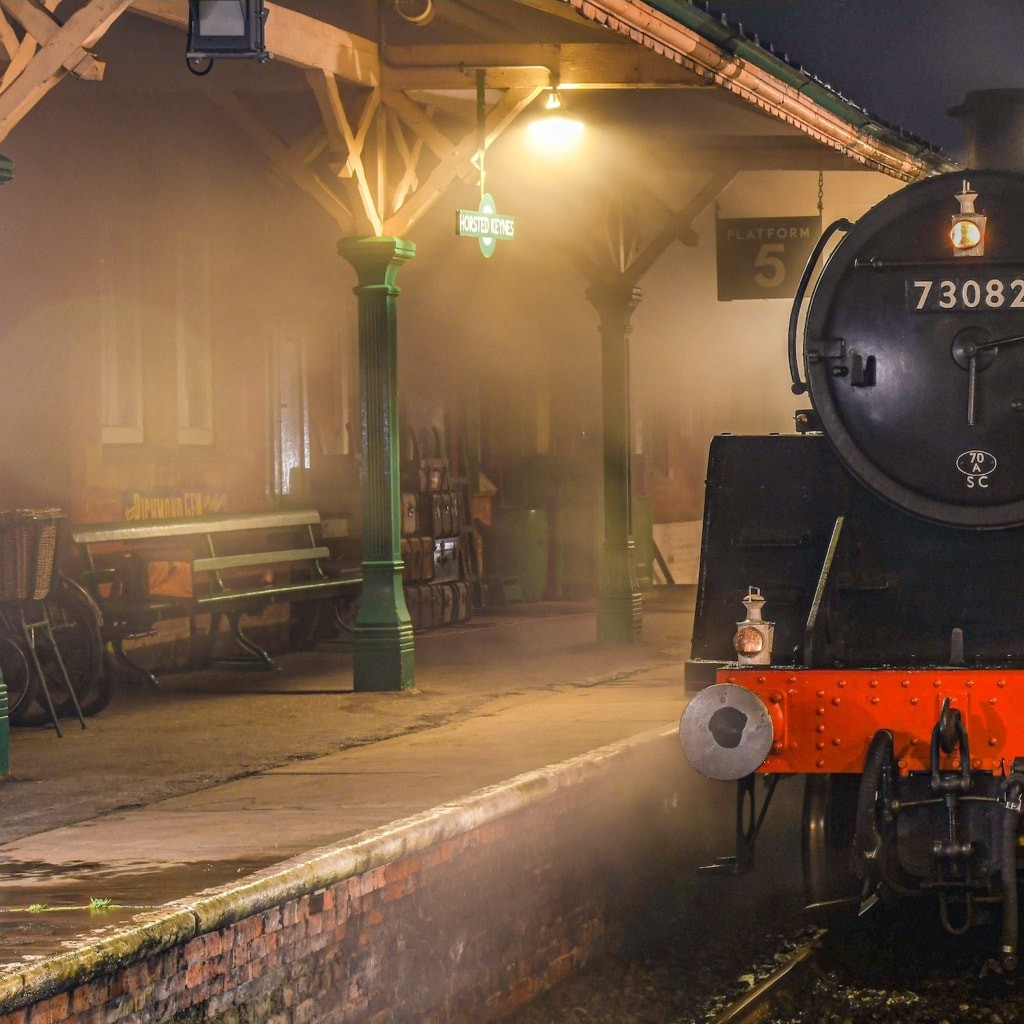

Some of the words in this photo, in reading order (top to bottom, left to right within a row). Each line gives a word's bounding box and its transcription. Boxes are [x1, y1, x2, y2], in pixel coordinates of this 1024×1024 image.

[459, 214, 490, 234] HORSTED
[490, 217, 515, 236] KEYNES
[727, 227, 810, 241] PLATFORM
[753, 243, 786, 288] 5
[969, 452, 985, 464] 70
[972, 462, 982, 473] A
